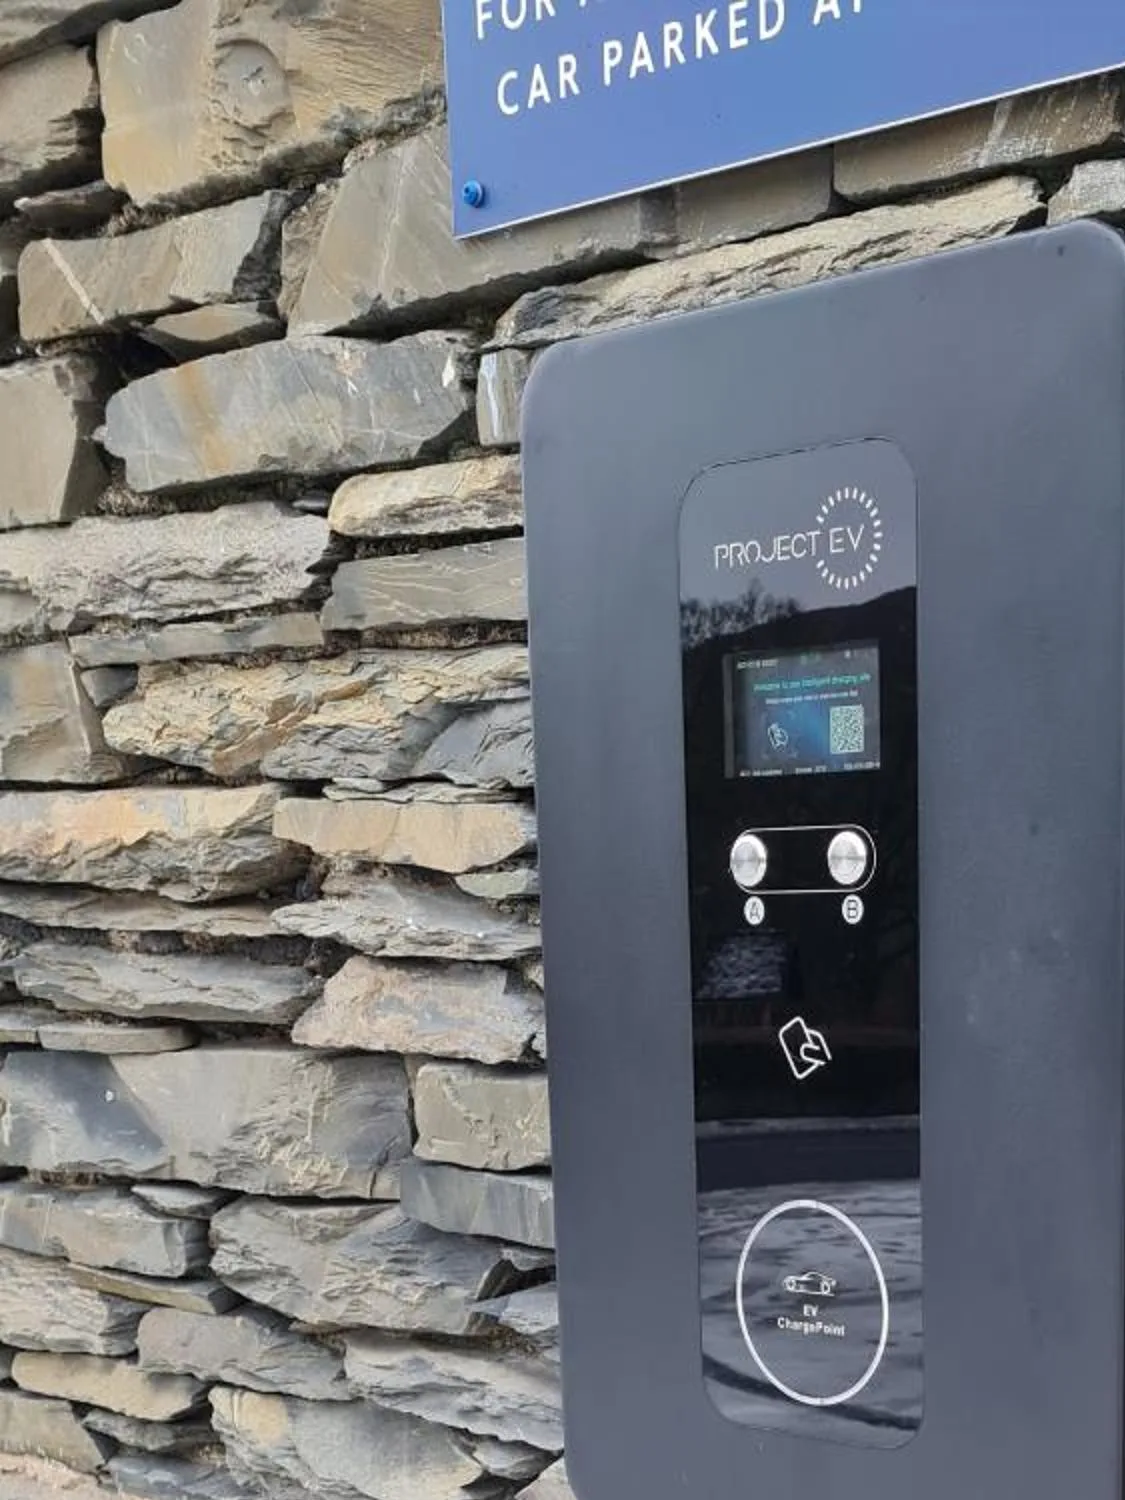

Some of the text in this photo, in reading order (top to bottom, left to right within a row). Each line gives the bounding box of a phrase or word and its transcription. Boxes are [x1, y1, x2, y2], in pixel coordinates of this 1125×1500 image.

[497, 0, 861, 115] CAR PARKED A
[714, 524, 865, 569] PROJECT EV
